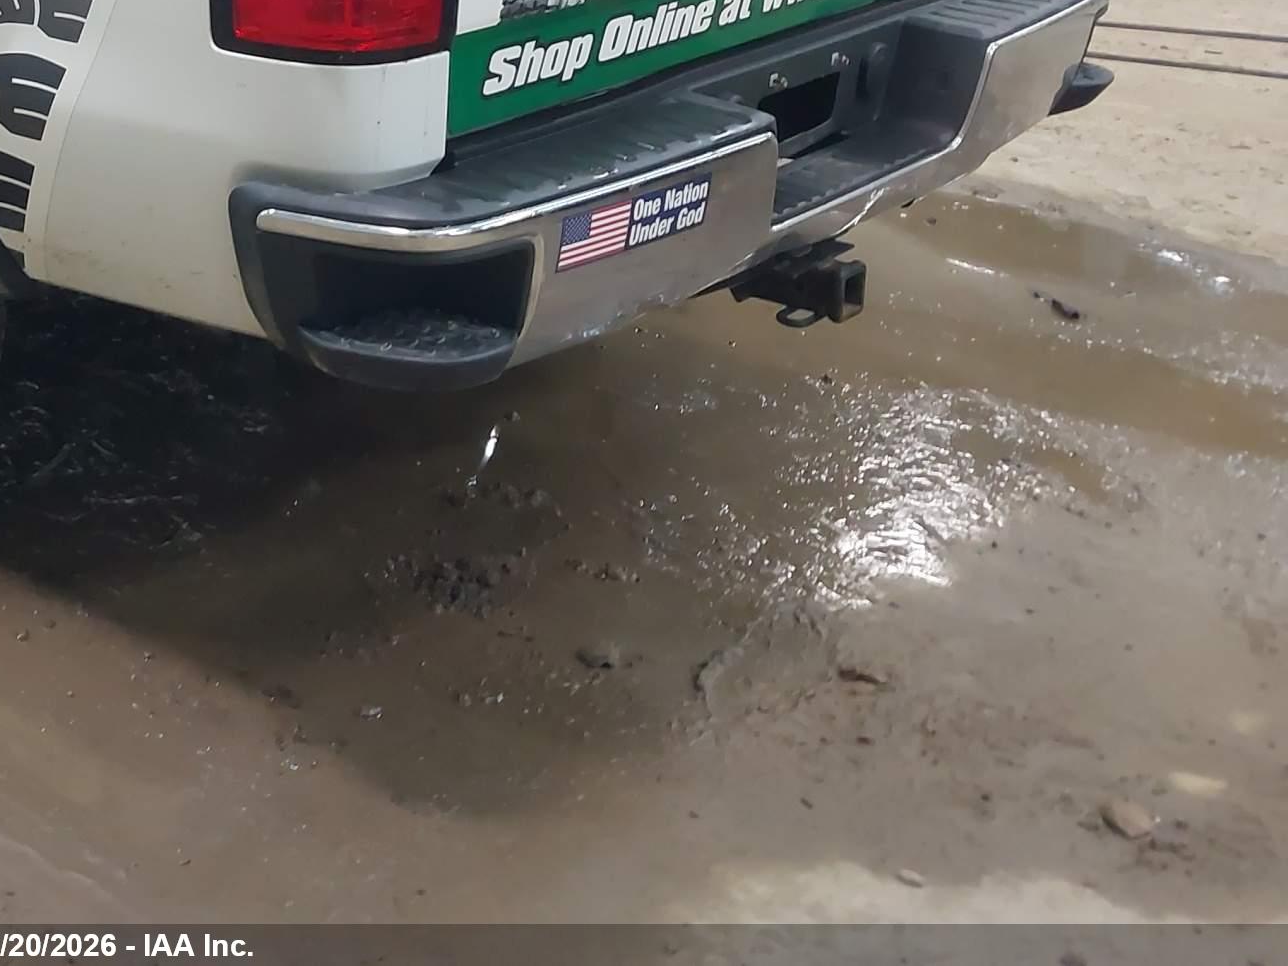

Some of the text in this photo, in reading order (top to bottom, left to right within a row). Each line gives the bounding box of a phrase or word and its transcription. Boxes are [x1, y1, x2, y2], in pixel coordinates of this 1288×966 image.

[483, 33, 594, 95] Shop
[598, 0, 716, 62] Online
[629, 201, 706, 246] Under God
[633, 181, 709, 221] One Nation
